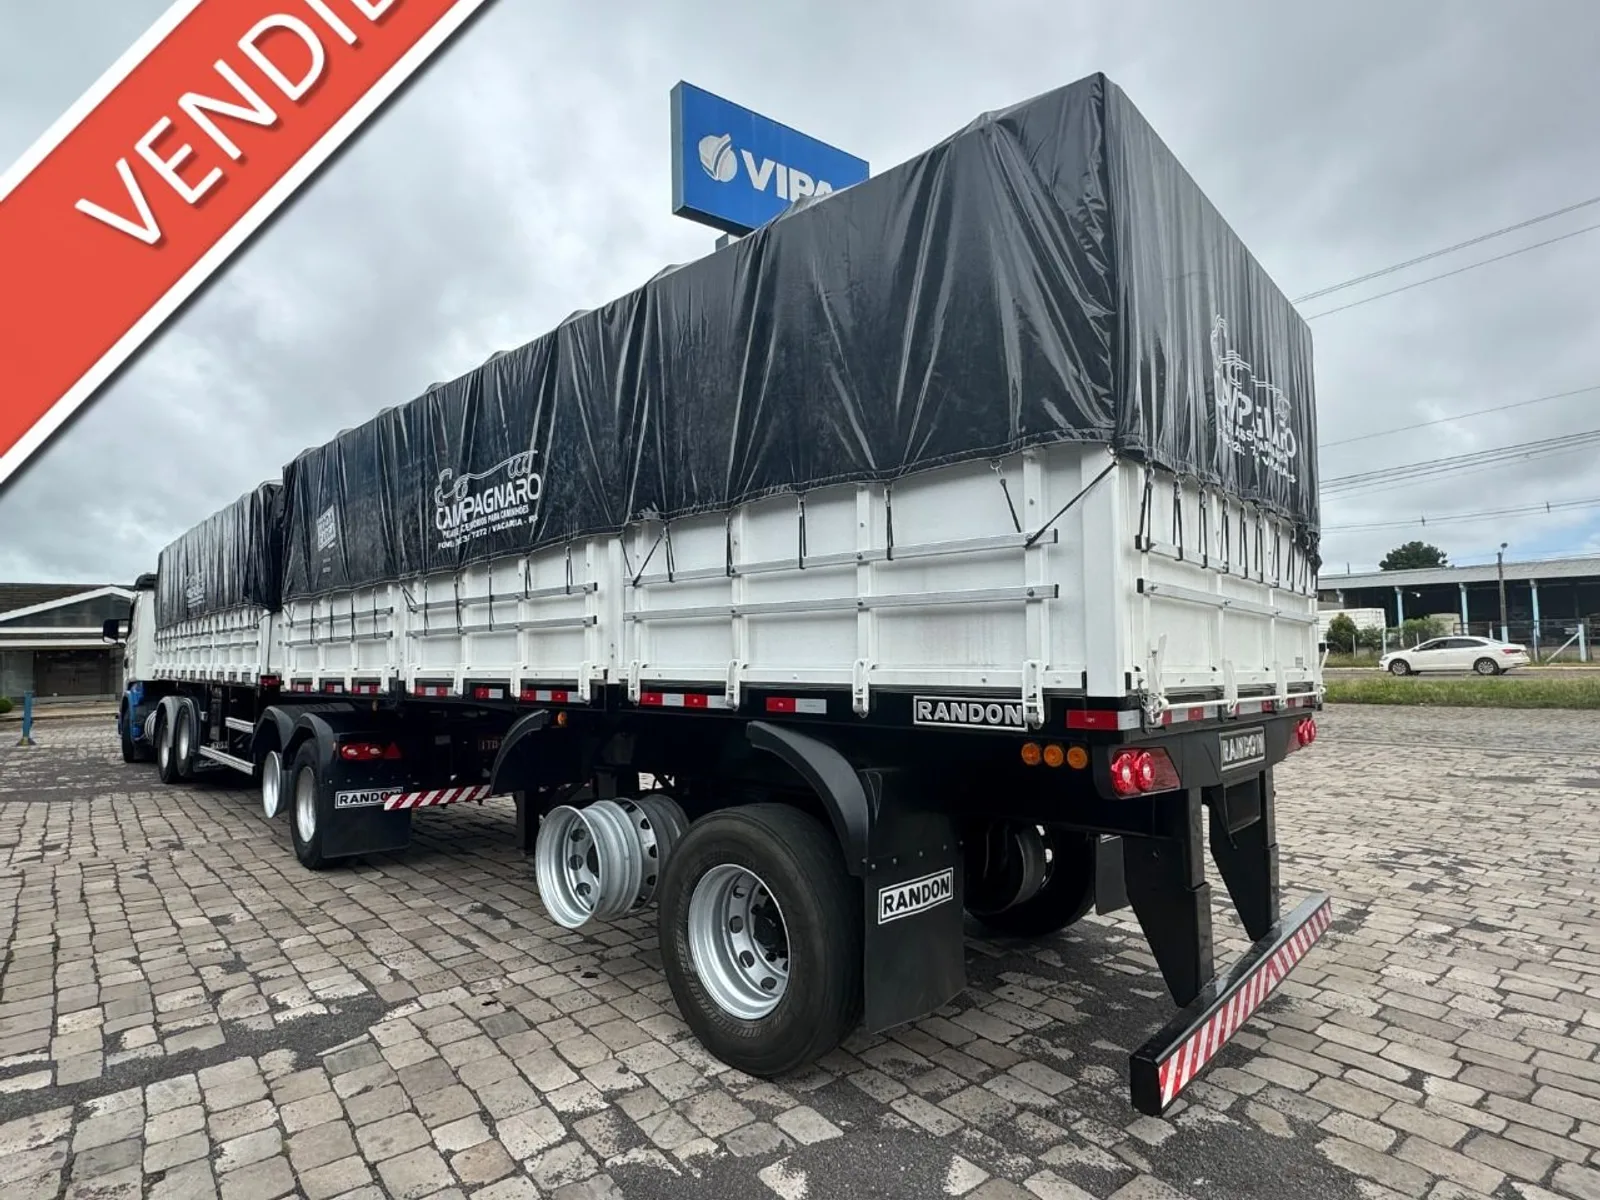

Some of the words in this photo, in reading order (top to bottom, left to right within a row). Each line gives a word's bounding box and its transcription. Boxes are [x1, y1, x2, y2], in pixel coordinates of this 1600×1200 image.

[436, 473, 541, 530] CAMPAGNARO
[917, 701, 1023, 725] RANDON
[1221, 733, 1264, 762] RANDON
[340, 790, 401, 805] RANDO
[883, 875, 950, 915] RANDON
